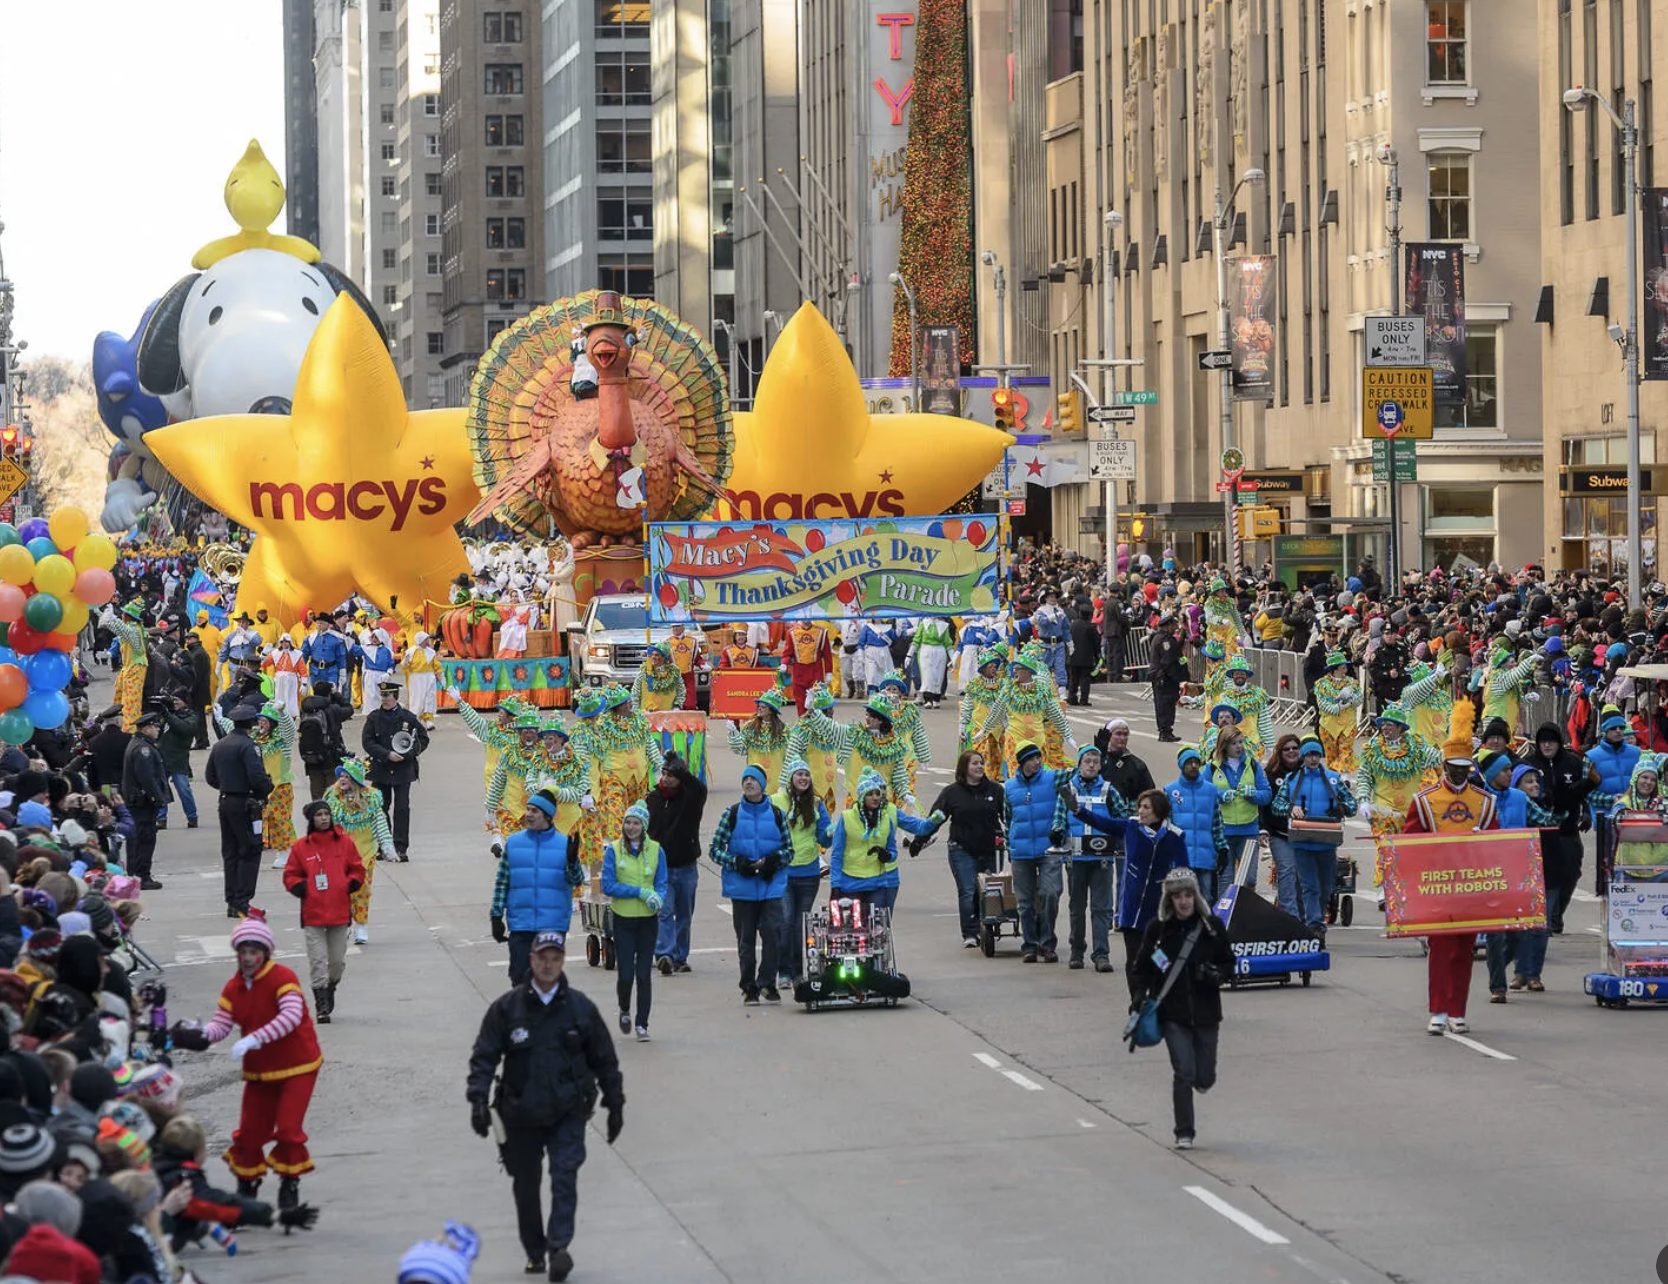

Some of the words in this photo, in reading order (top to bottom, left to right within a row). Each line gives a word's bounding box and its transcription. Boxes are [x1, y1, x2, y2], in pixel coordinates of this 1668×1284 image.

[1423, 250, 1447, 260] NYC
[1242, 262, 1263, 271] NYC
[1377, 322, 1415, 332] BUSES
[1382, 334, 1411, 344] ONLY
[1213, 355, 1229, 364] ONE
[1369, 373, 1427, 384] CAUTION
[1125, 393, 1133, 403] W
[1134, 393, 1147, 403] 49
[1369, 389, 1427, 398] RECESSED
[1368, 400, 1428, 410] CRWALK
[1097, 442, 1127, 451] BUSES
[1100, 456, 1125, 465] ONLY
[1254, 478, 1292, 490] Subway
[250, 476, 447, 532] macys
[680, 534, 773, 568] Macy's
[714, 541, 882, 606] Thanksgiving
[889, 537, 942, 571] Day
[880, 573, 962, 608] Parade
[1421, 869, 1455, 882] FIRST
[1459, 866, 1503, 880] TEAMS
[1418, 883, 1452, 895] WITH
[1455, 879, 1508, 894] ROBOTS
[1611, 884, 1636, 893] FedEx
[1618, 980, 1644, 997] 180
